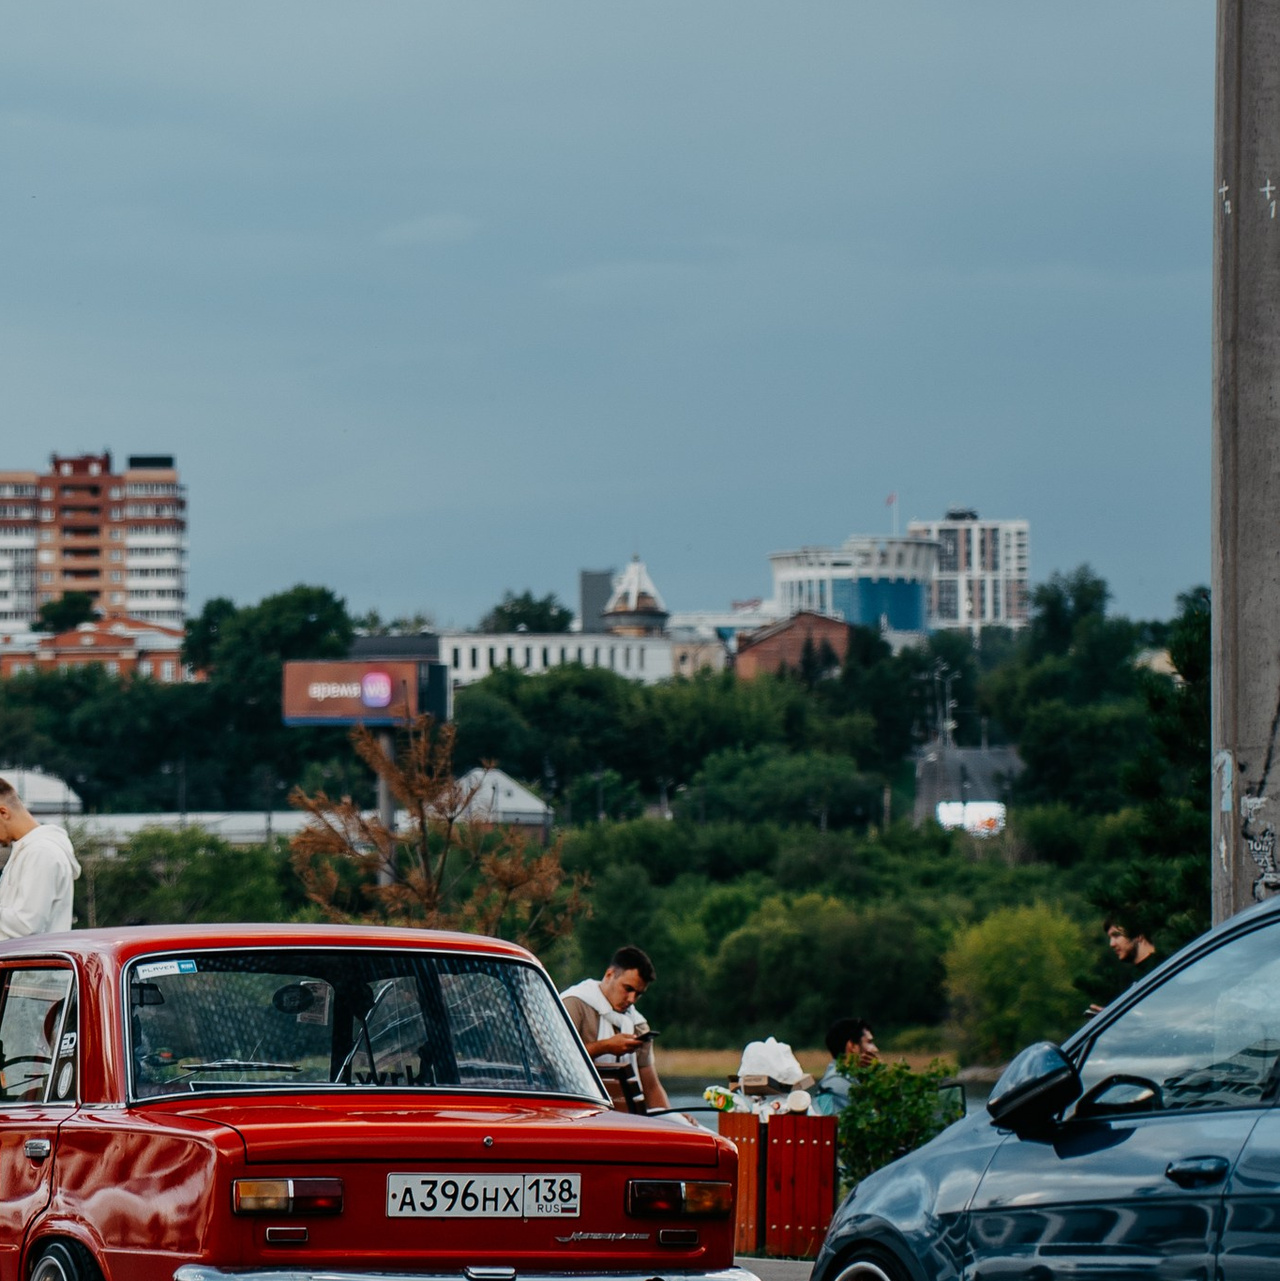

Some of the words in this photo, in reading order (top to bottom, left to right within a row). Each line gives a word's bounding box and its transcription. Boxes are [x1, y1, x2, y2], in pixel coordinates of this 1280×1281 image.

[399, 1179, 521, 1212] А396НХ
[528, 1178, 573, 1202] 138
[536, 1203, 560, 1213] RUS
